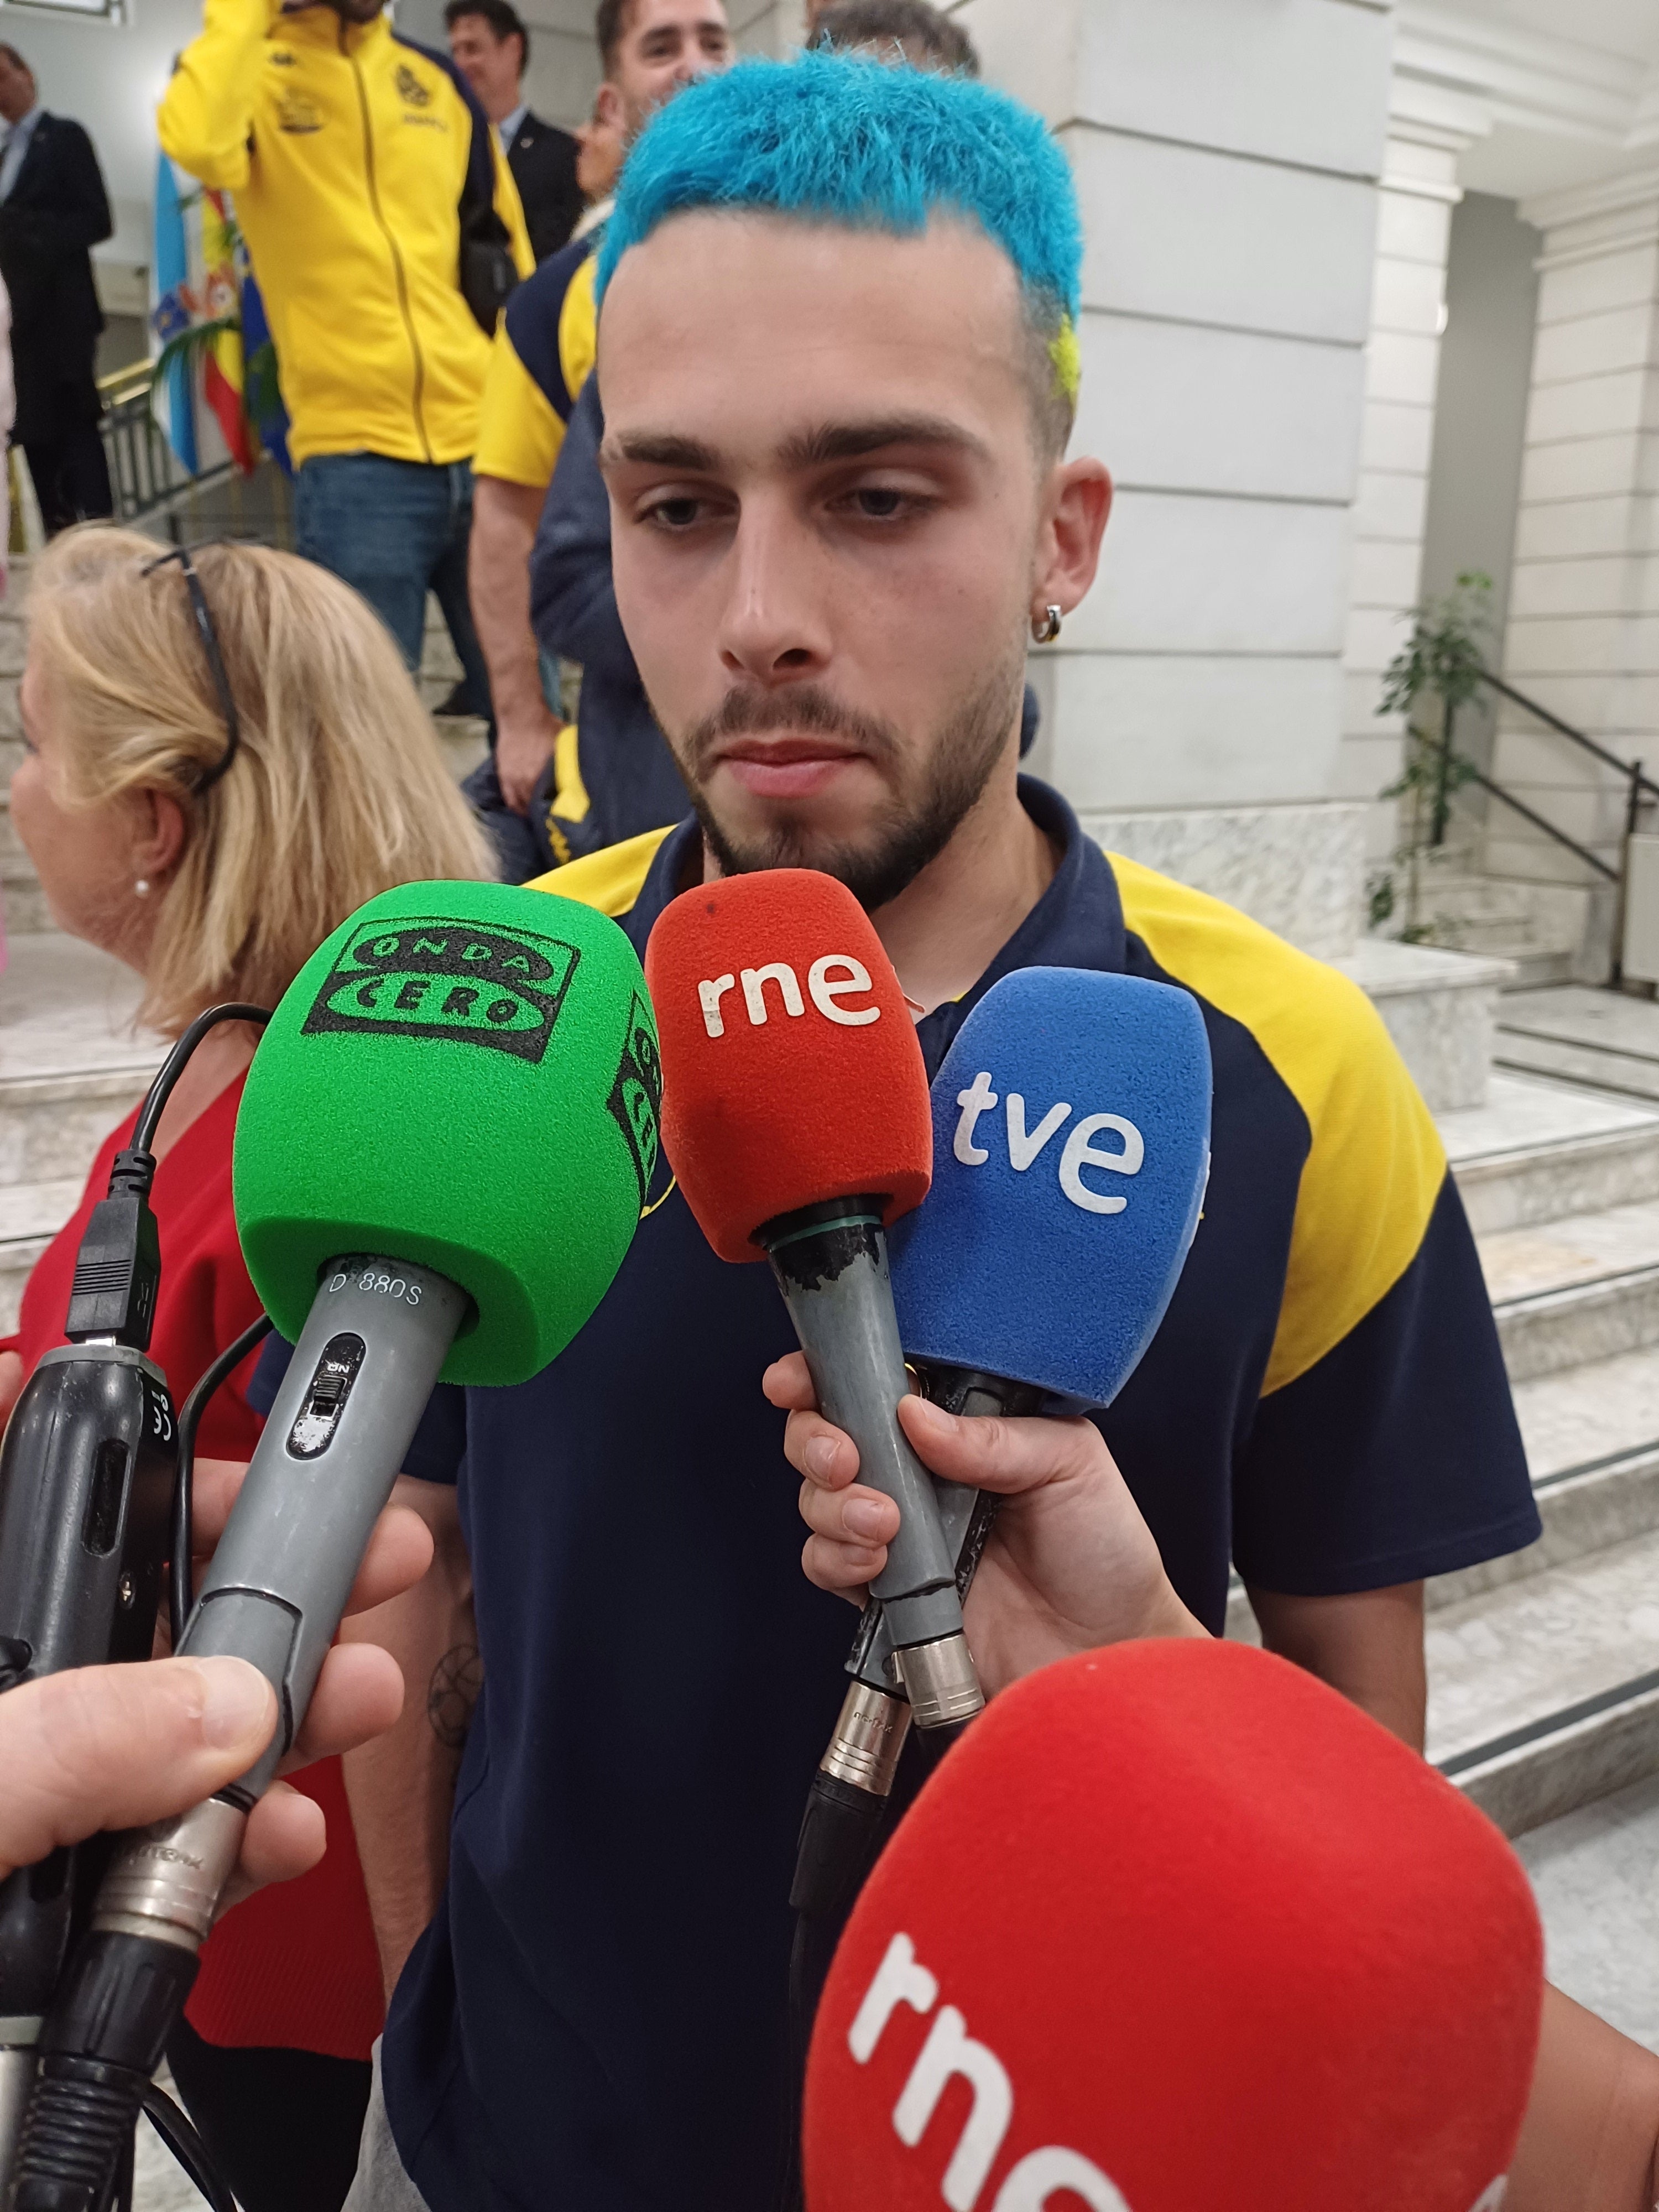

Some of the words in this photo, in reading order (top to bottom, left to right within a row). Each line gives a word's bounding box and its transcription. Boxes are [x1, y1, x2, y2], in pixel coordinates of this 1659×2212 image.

[372, 937, 530, 973] ONDA
[356, 978, 518, 1023] CERO
[697, 954, 881, 1037] rne
[953, 1071, 1144, 1214] tve
[329, 1274, 347, 1292] D
[359, 1272, 422, 1305] 880S
